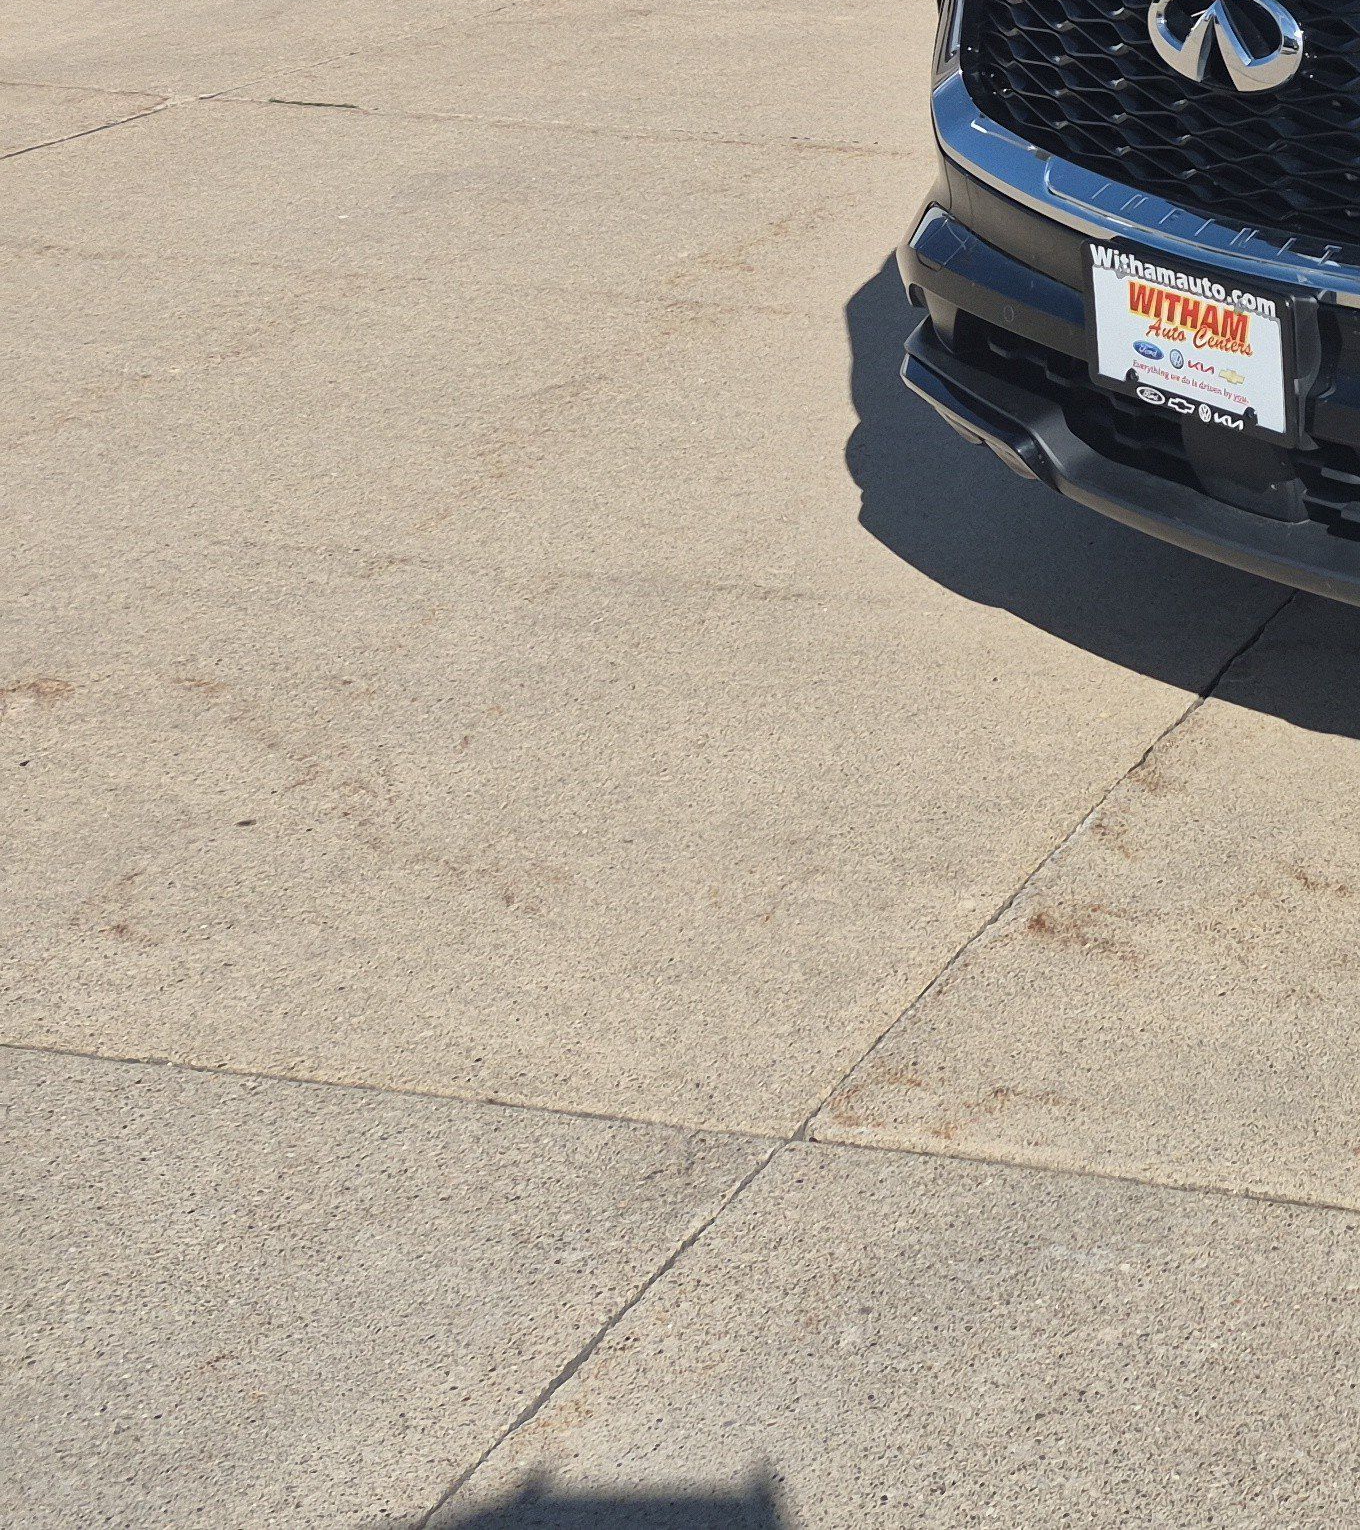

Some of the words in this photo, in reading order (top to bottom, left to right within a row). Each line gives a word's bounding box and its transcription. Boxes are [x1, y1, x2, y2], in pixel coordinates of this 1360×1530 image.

[1089, 243, 1277, 318] Withamauto.com
[1129, 281, 1248, 343] WITHAM
[1135, 341, 1161, 359] Ford
[1145, 317, 1187, 342] Auto
[1192, 325, 1253, 357] Centers
[1132, 359, 1169, 380] Everything
[1170, 373, 1181, 382] we
[1181, 375, 1191, 385] do
[1198, 380, 1223, 396] driven
[1223, 387, 1233, 400] by
